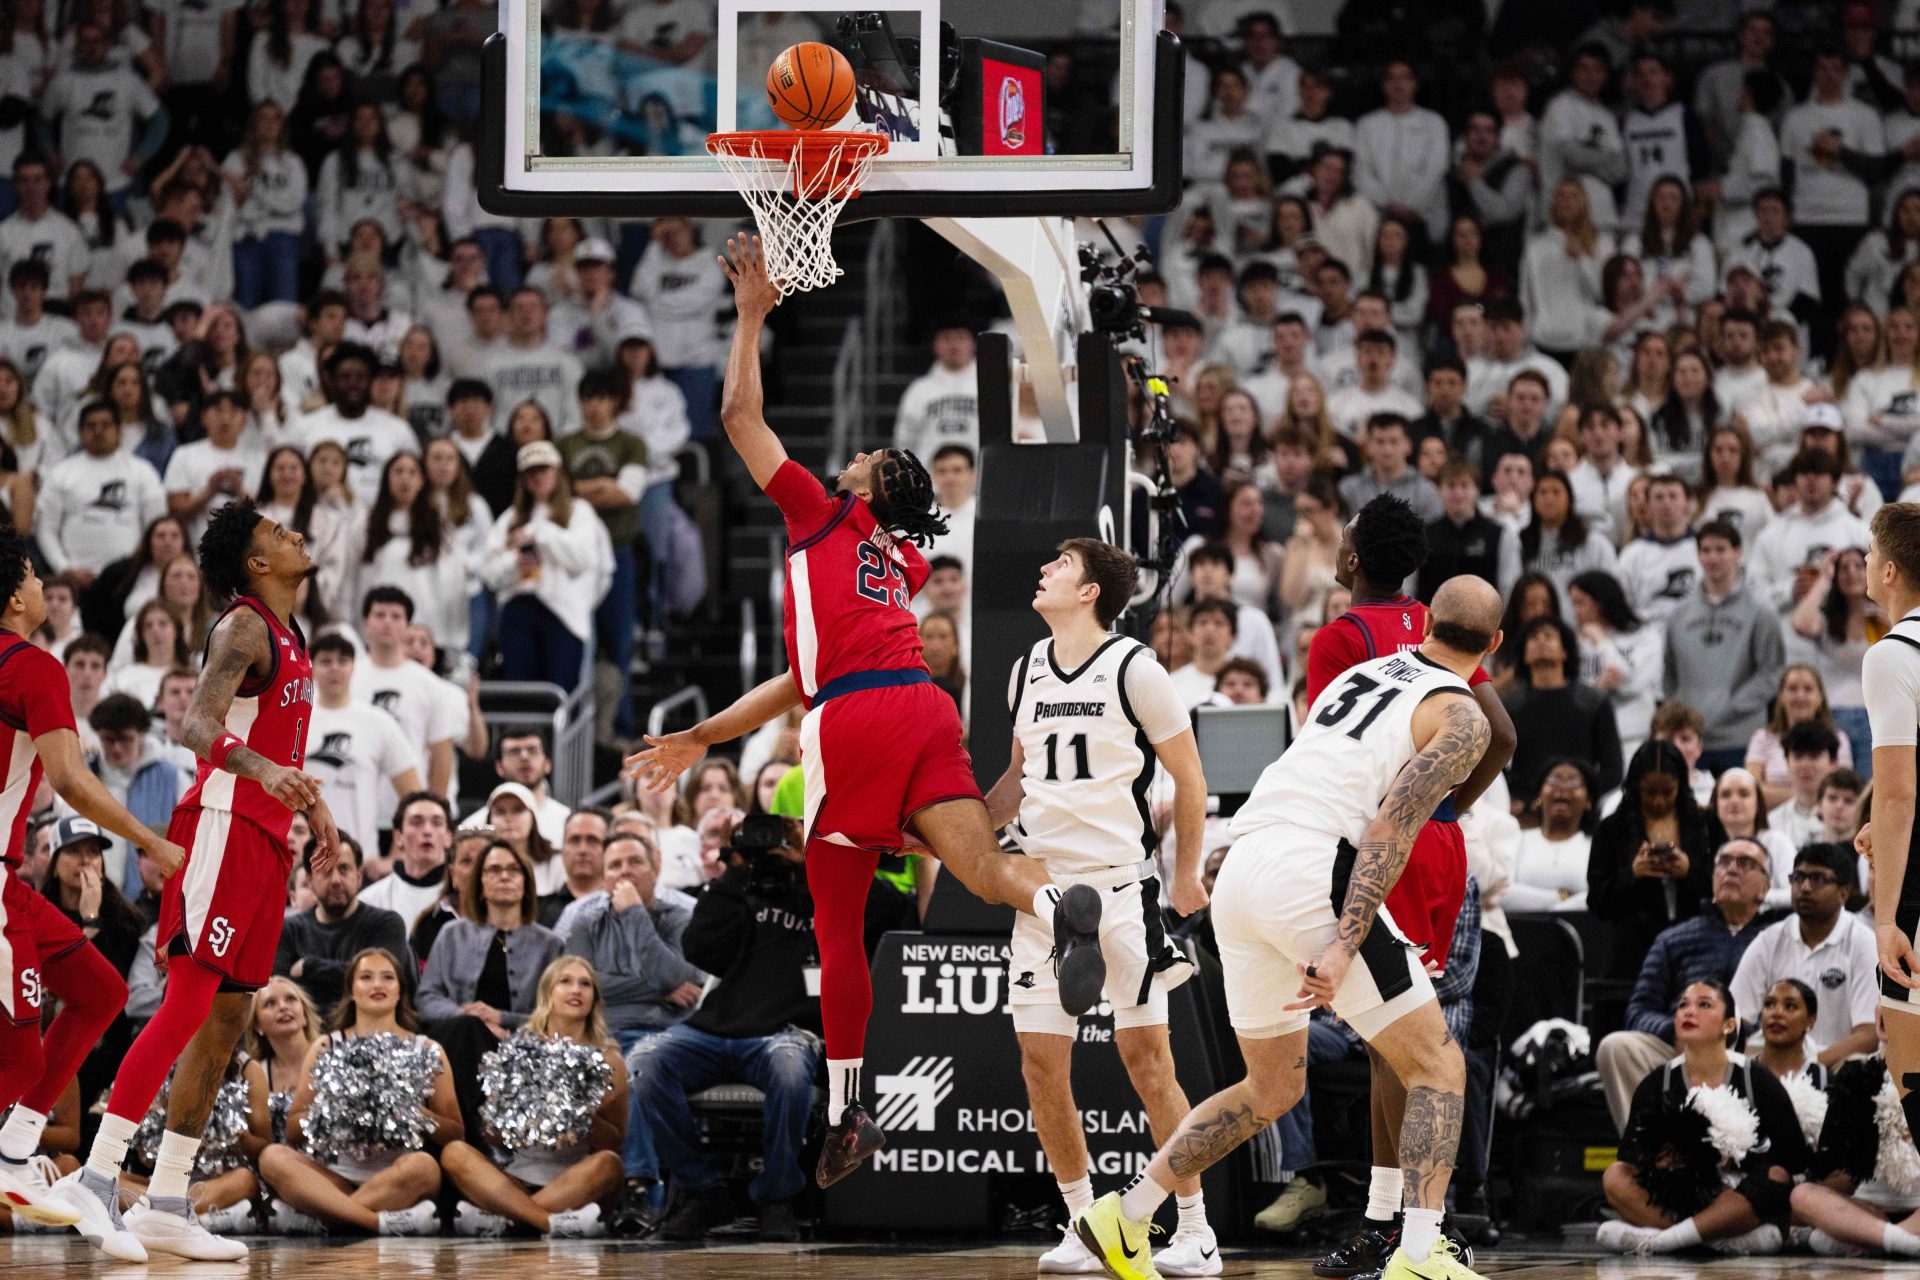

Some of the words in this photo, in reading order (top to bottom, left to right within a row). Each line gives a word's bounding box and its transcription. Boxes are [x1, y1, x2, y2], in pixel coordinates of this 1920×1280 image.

[1378, 658, 1429, 683] POWELL
[1033, 701, 1106, 723] PROVIDENCE
[1315, 672, 1403, 741] 31
[291, 717, 303, 762] 1
[1042, 733, 1096, 781] 11
[902, 945, 948, 961] NEW
[951, 945, 1013, 961] ENGLA
[1082, 1024, 1112, 1043] the
[873, 1149, 1025, 1174] MEDICAL
